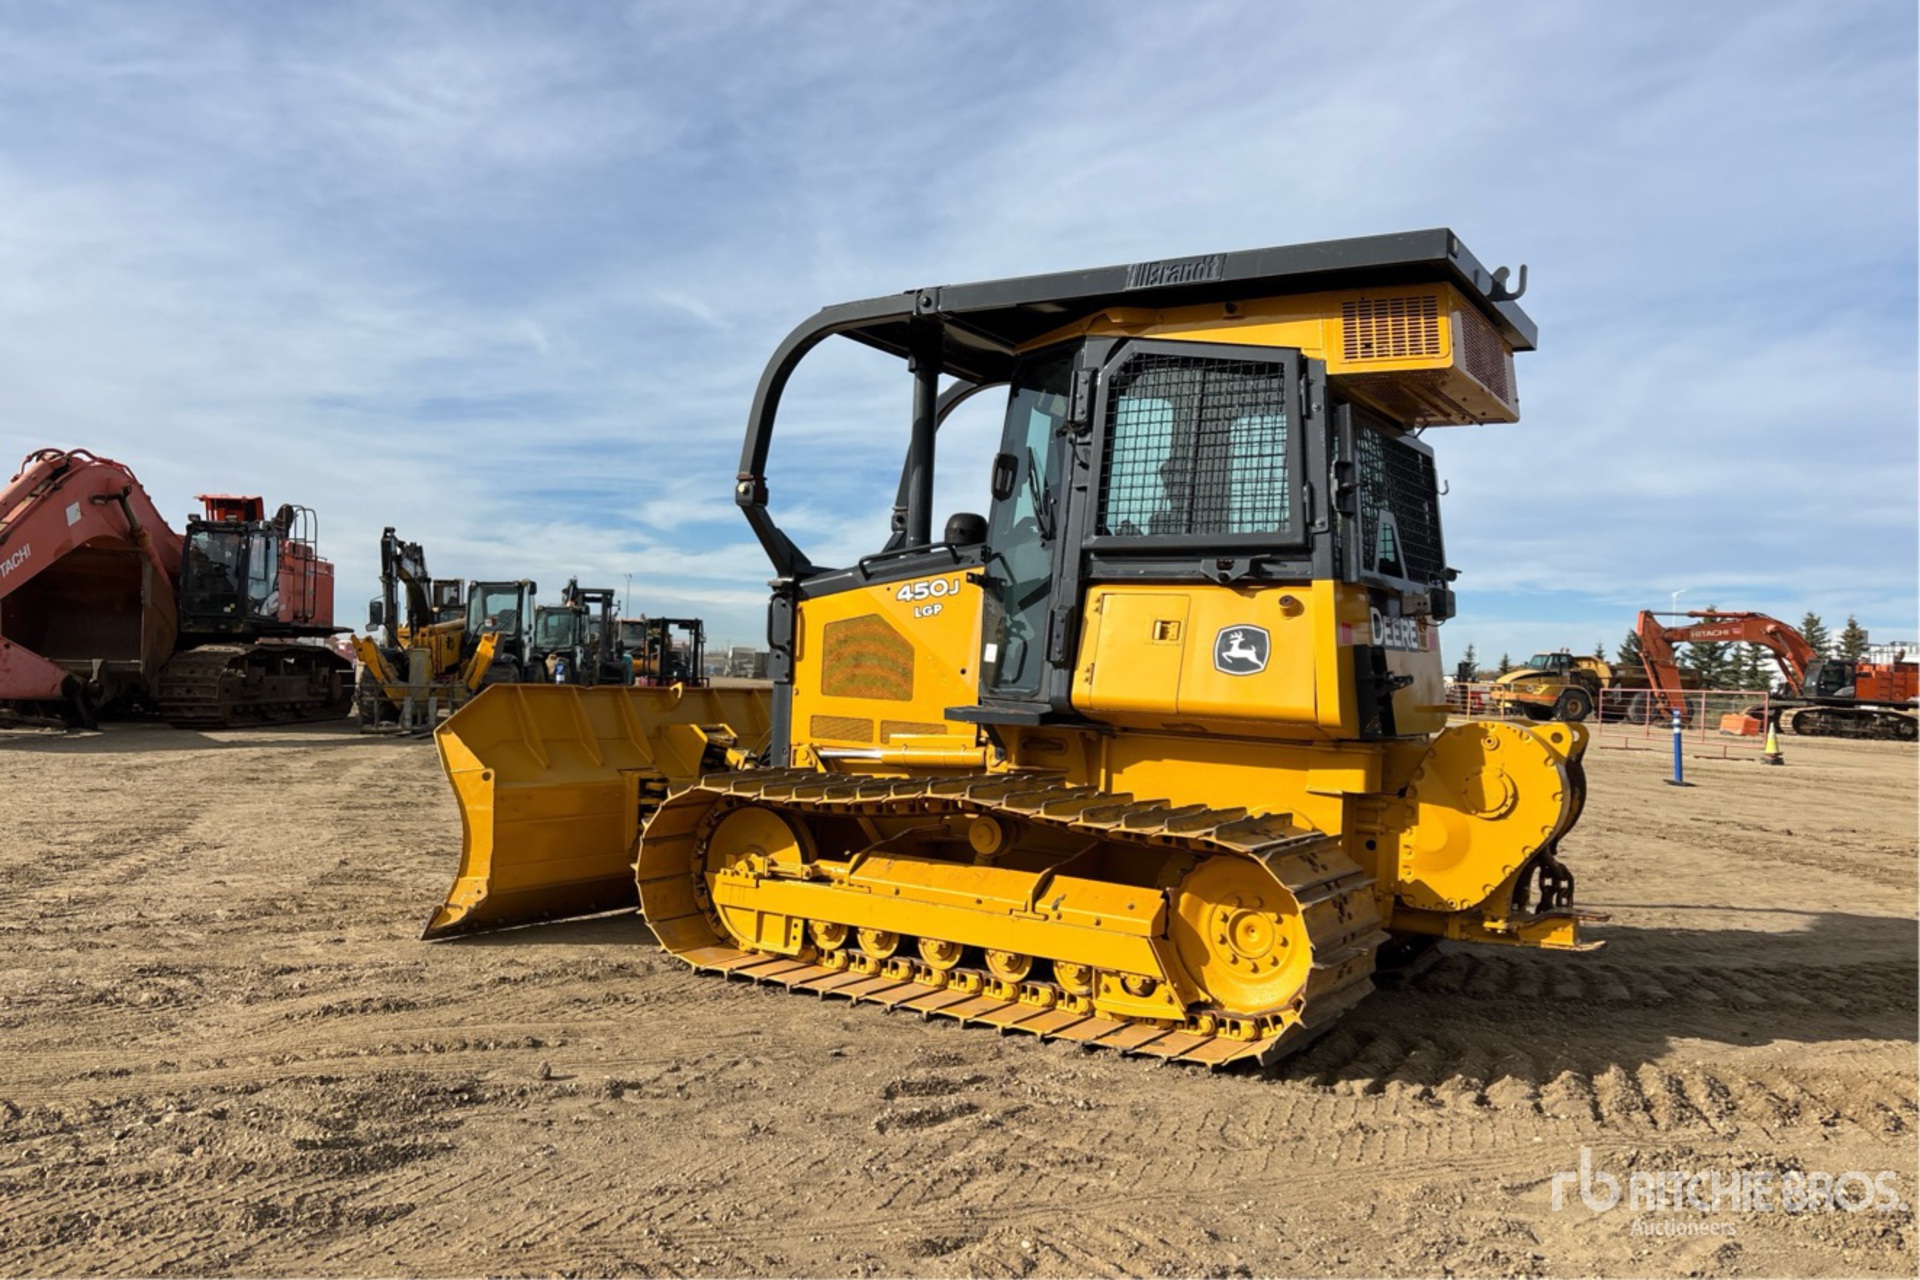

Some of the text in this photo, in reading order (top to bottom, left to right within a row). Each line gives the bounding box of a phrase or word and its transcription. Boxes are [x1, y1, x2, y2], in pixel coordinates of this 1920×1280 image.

[1143, 255, 1219, 286] Brandt
[896, 578, 961, 602] 450J
[914, 603, 943, 618] LGP
[1690, 629, 1730, 638] HITACHI
